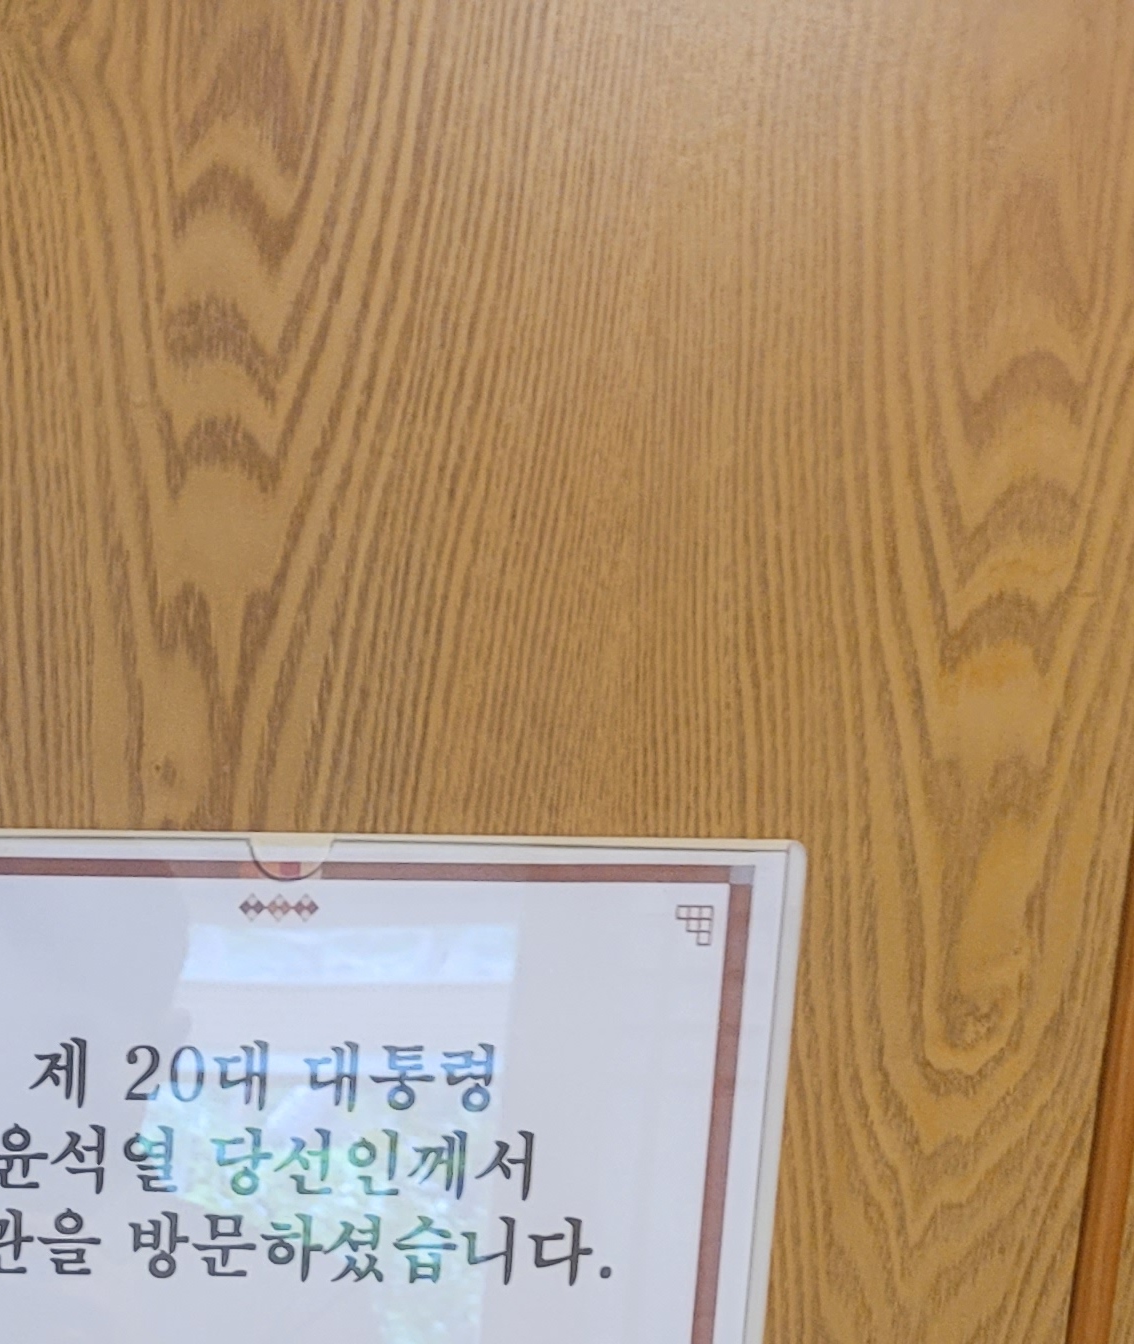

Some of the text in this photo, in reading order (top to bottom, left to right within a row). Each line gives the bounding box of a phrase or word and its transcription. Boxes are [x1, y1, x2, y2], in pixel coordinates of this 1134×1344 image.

[29, 1037, 496, 1113] 제 20대 대통령
[210, 1126, 535, 1201] 당선인께서
[128, 1211, 612, 1287] 방문하셨습니다.
